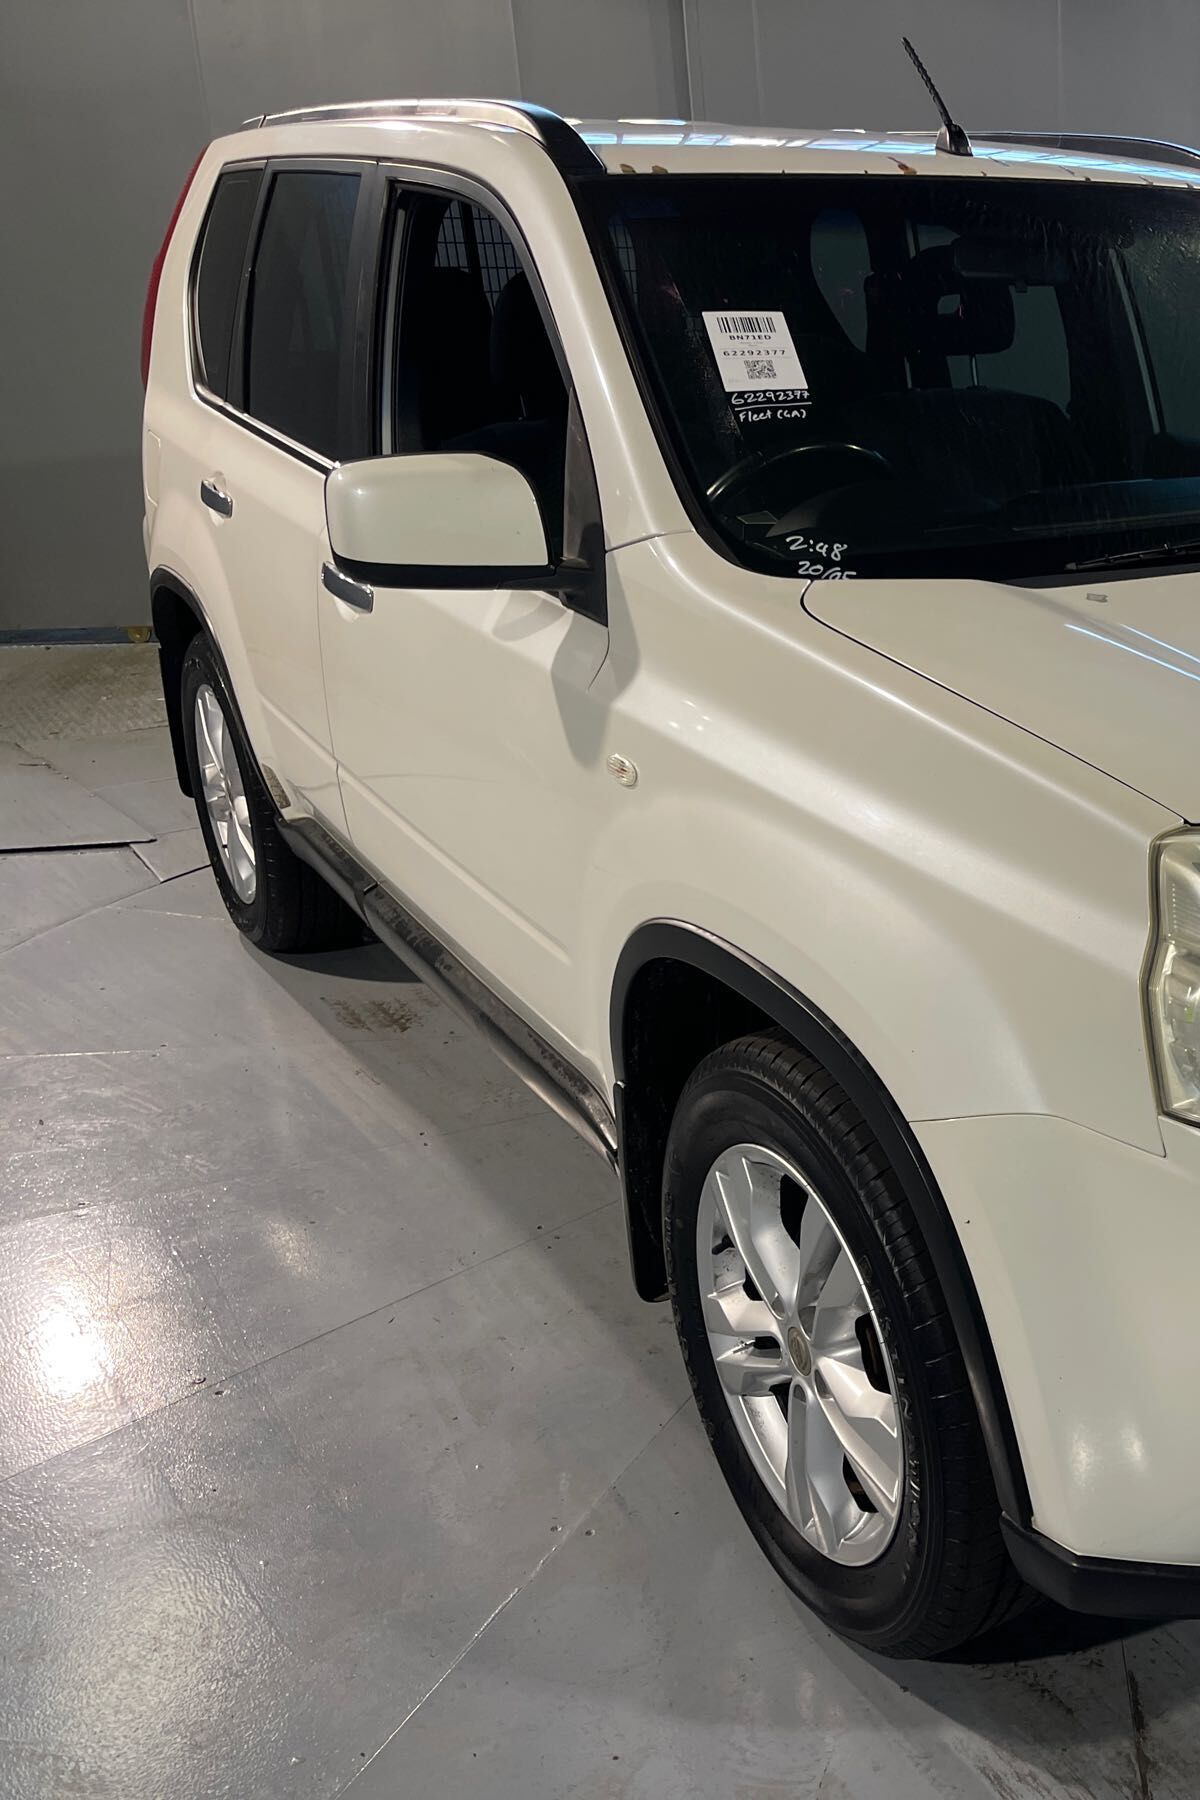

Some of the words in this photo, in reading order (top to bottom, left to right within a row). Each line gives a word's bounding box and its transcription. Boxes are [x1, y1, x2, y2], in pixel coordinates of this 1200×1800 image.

[723, 349, 786, 357] 62292377
[732, 390, 810, 405] 62292377
[739, 409, 772, 422] Fleet
[785, 535, 848, 561] 2:48
